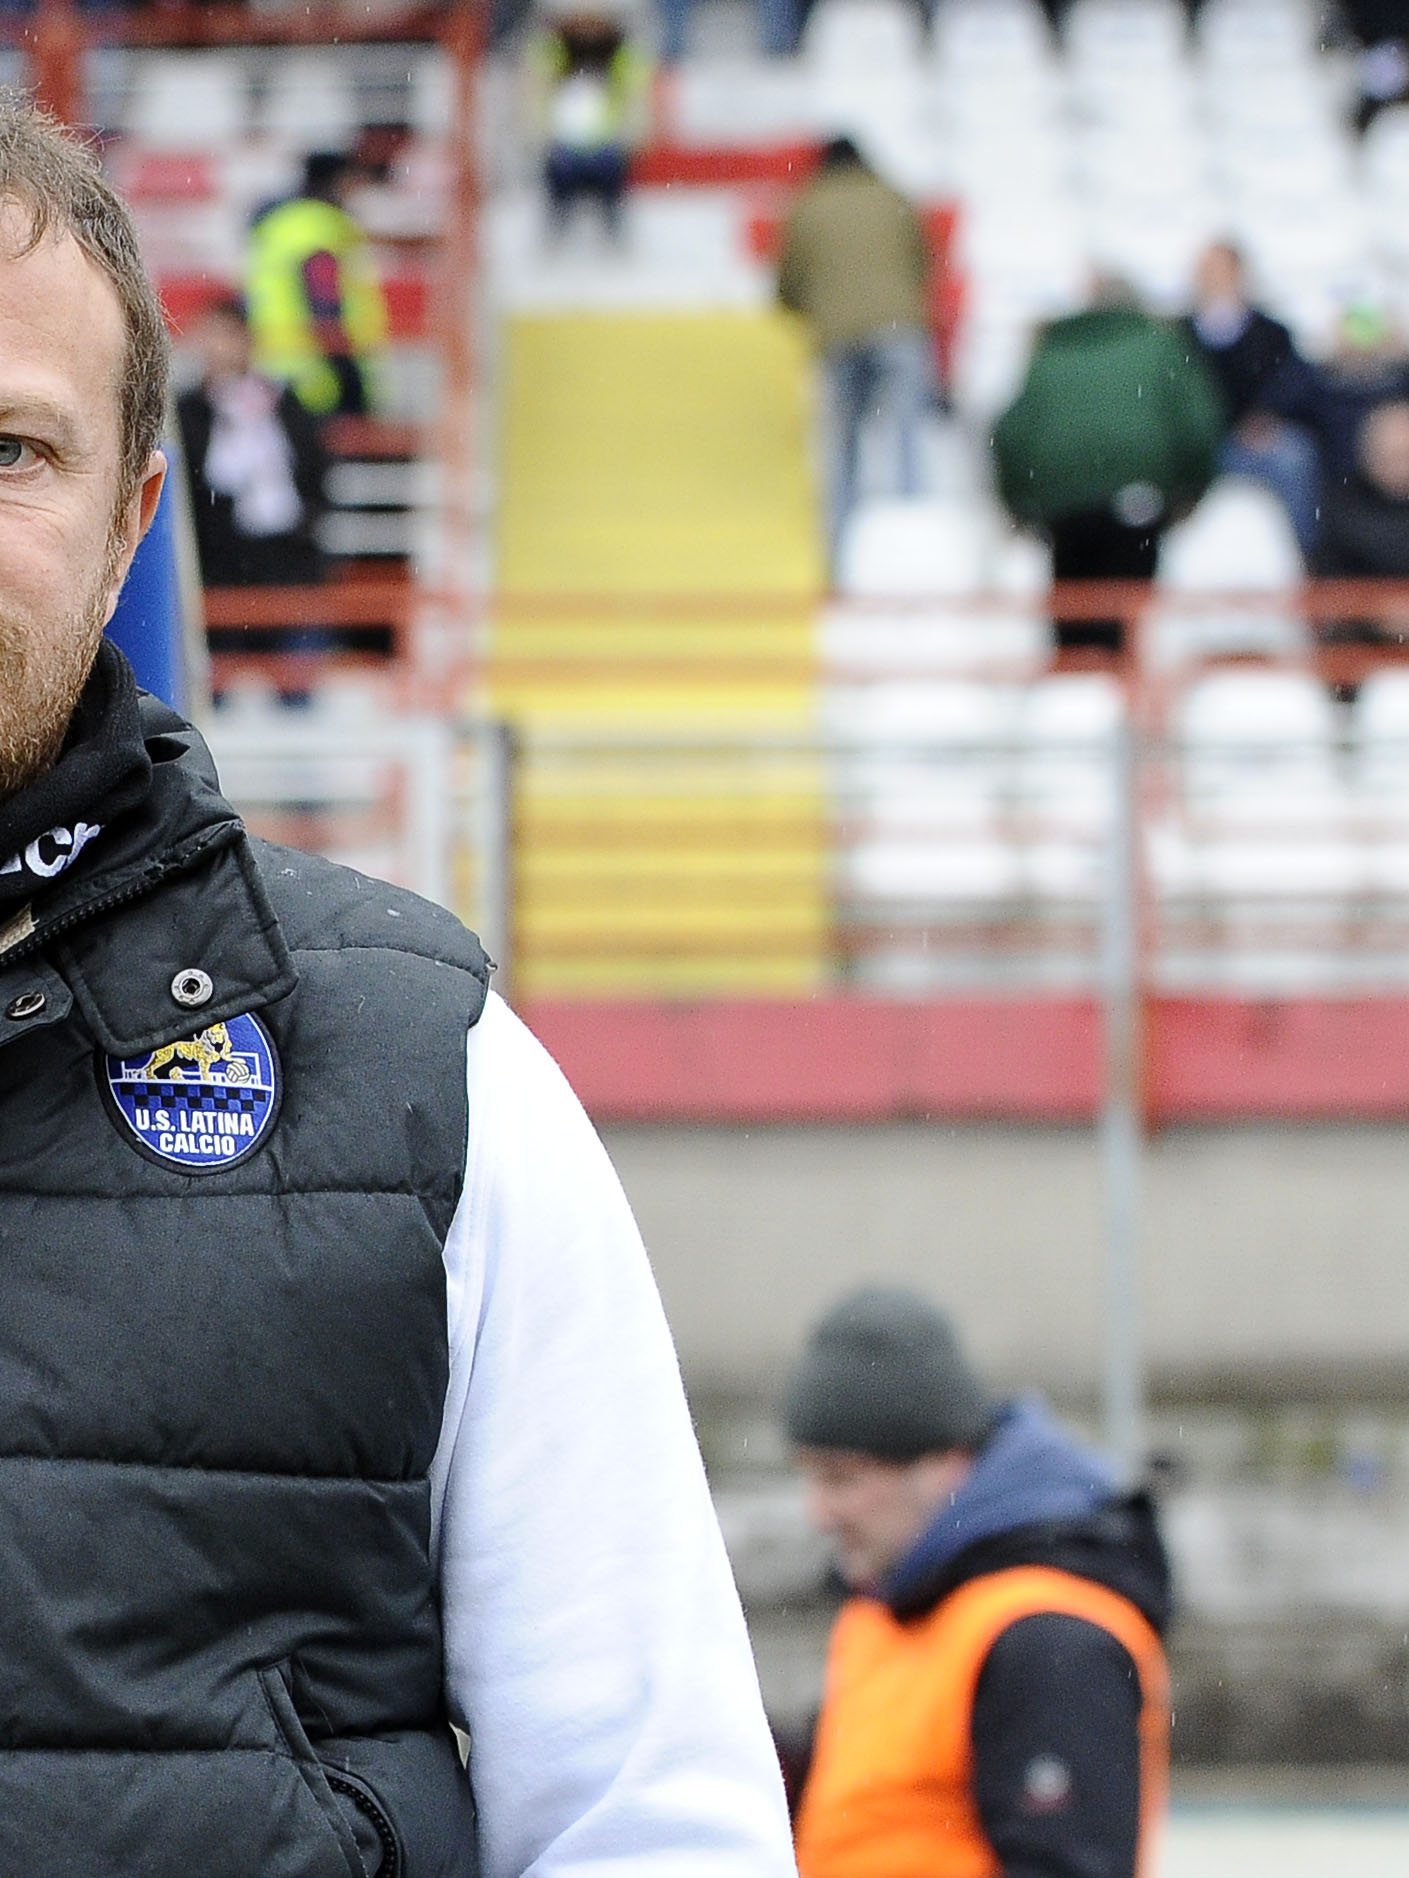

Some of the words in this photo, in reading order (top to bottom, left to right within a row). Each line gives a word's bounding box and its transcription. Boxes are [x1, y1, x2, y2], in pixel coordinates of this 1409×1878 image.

[135, 1109, 176, 1132] U.S.
[180, 1110, 255, 1137] LATINA
[159, 1132, 236, 1156] CALCIO
